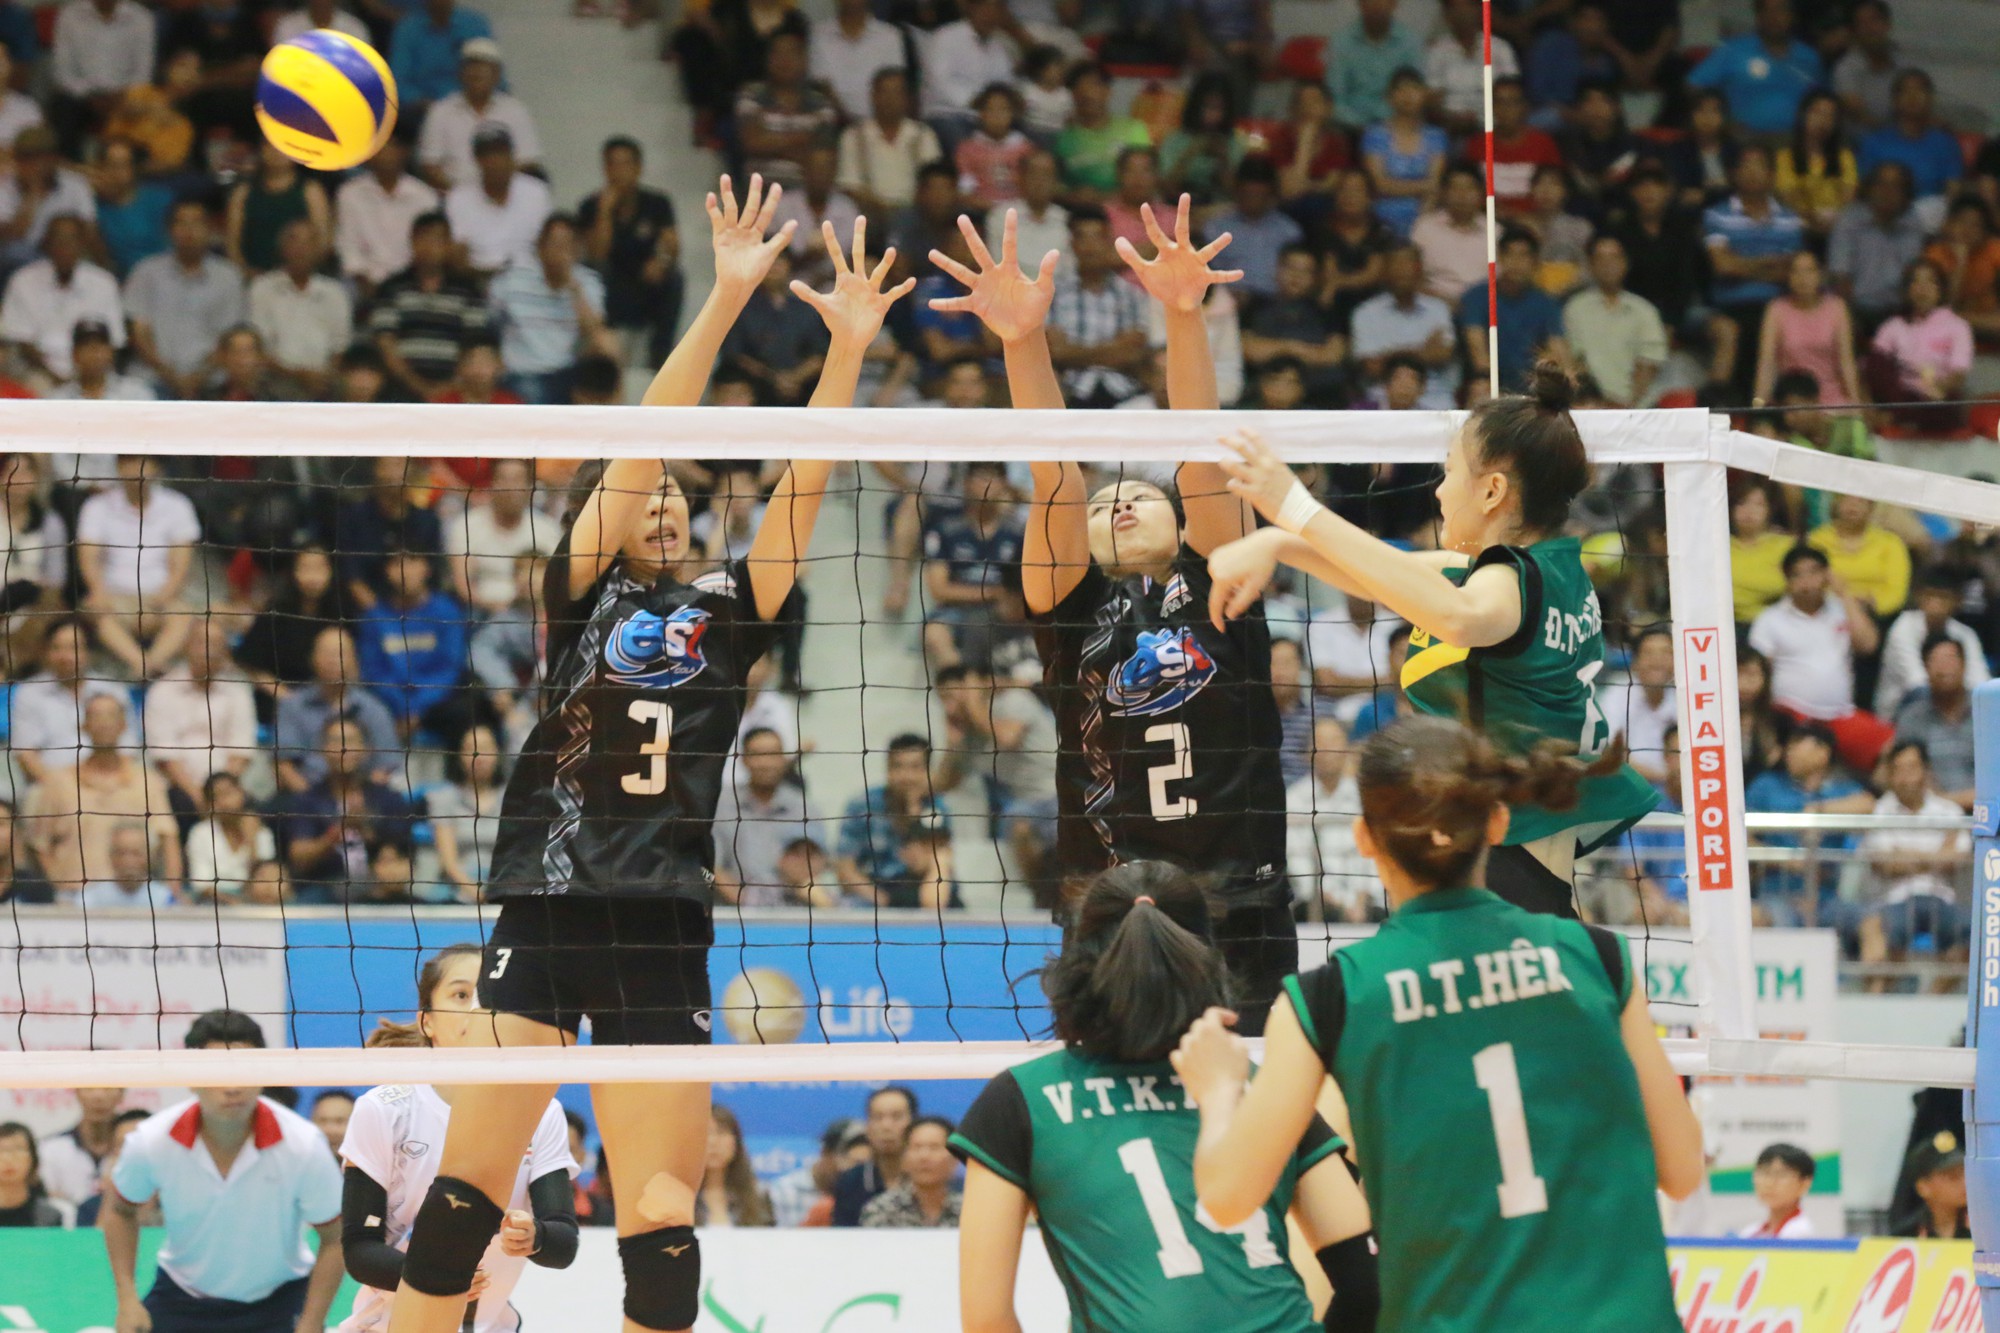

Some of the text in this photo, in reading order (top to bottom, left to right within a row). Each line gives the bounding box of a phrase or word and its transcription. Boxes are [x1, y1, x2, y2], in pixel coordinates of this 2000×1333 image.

[1160, 592, 1194, 619] THA
[620, 699, 674, 796] 3
[1144, 722, 1198, 823] 2
[1690, 635, 1727, 885] VIFASPORT
[489, 948, 513, 979] 3
[1984, 887, 2000, 1008] Senoh
[819, 986, 914, 1037] Life
[1042, 1075, 1200, 1124] V.T.K.T
[1472, 1041, 1548, 1219] 1
